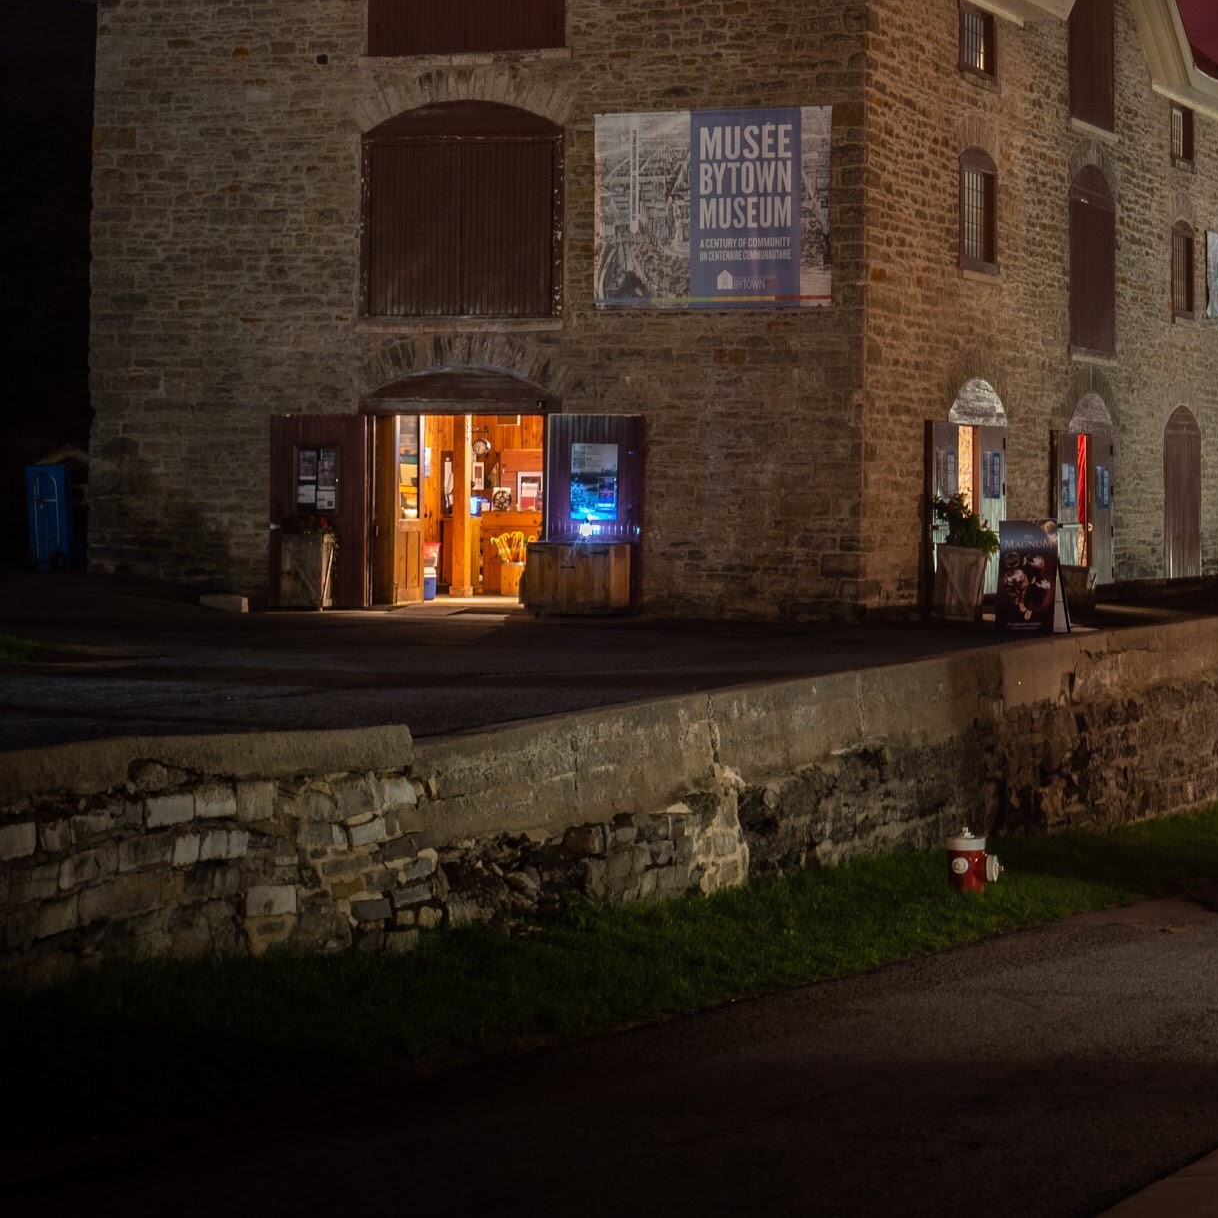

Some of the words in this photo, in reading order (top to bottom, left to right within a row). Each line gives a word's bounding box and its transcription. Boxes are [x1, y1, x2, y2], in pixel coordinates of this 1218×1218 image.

[700, 122, 792, 160] MUSÉE
[700, 160, 792, 195] BYTOWN
[700, 196, 792, 229] MUSEUM
[700, 238, 705, 248] A
[705, 238, 737, 248] CENTURY
[738, 238, 746, 247] OF
[748, 236, 791, 247] COMMUNITY
[700, 250, 708, 261] UN
[708, 250, 742, 261] CENTENAIRE
[743, 249, 792, 260] COMMUNAUTAIRE
[733, 278, 765, 289] BYTOWN
[1005, 539, 1054, 549] MAGNUM
